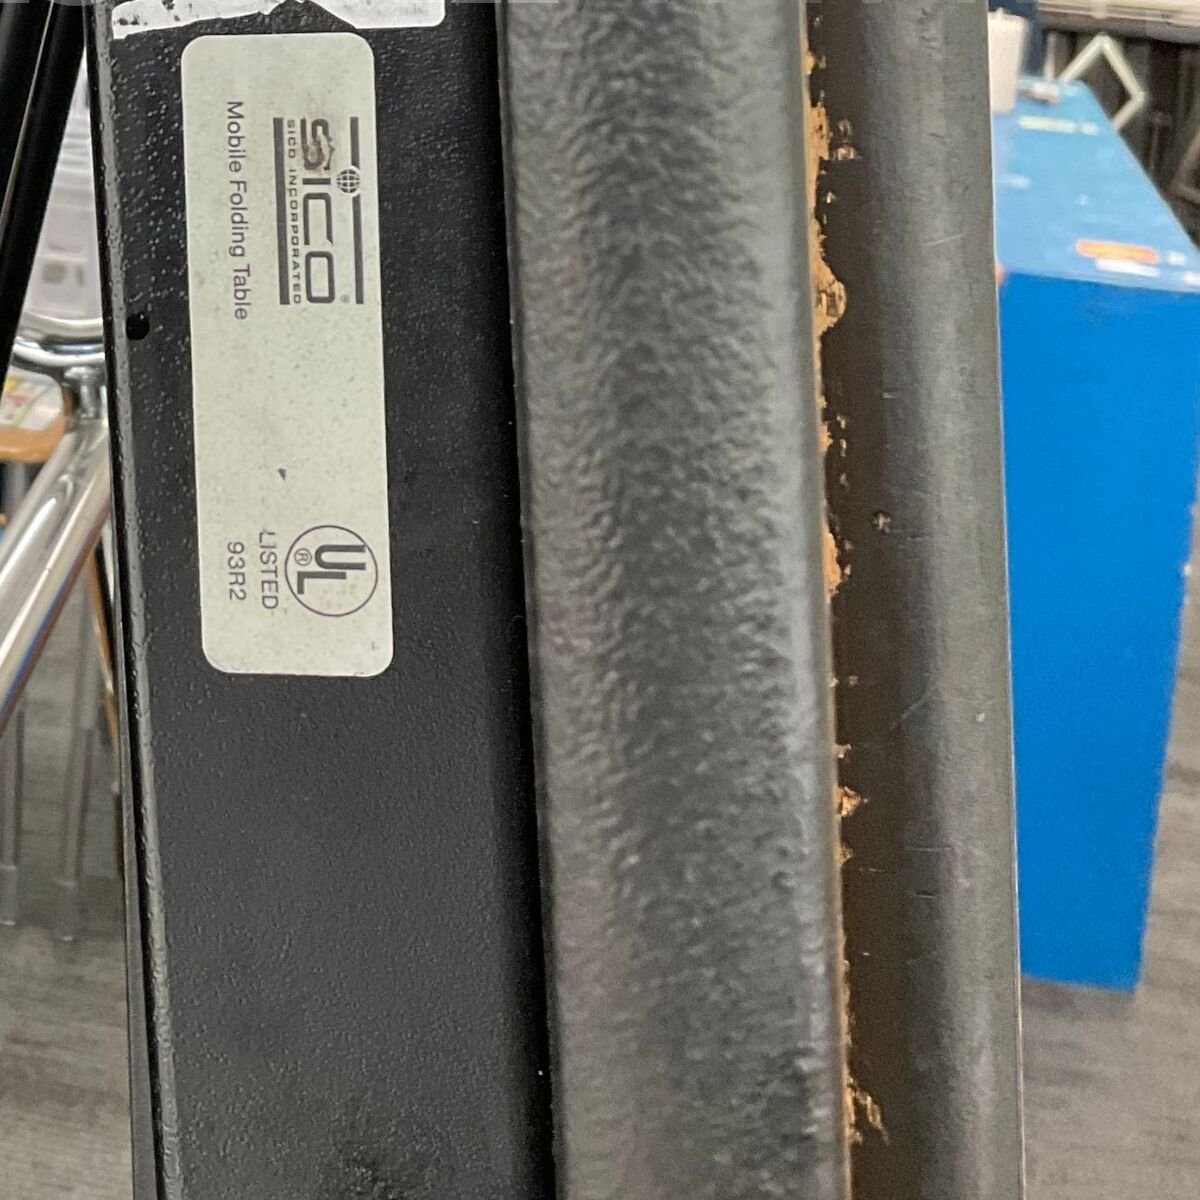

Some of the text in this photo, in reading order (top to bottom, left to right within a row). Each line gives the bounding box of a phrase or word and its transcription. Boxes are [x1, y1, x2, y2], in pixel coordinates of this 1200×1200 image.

[226, 100, 253, 321] Mobile Folding Table
[286, 119, 302, 305] SICO INCORPORATED
[300, 116, 336, 304] SICO
[227, 541, 247, 601] 93R2
[259, 530, 279, 610] LISTED
[296, 543, 367, 596] UL
